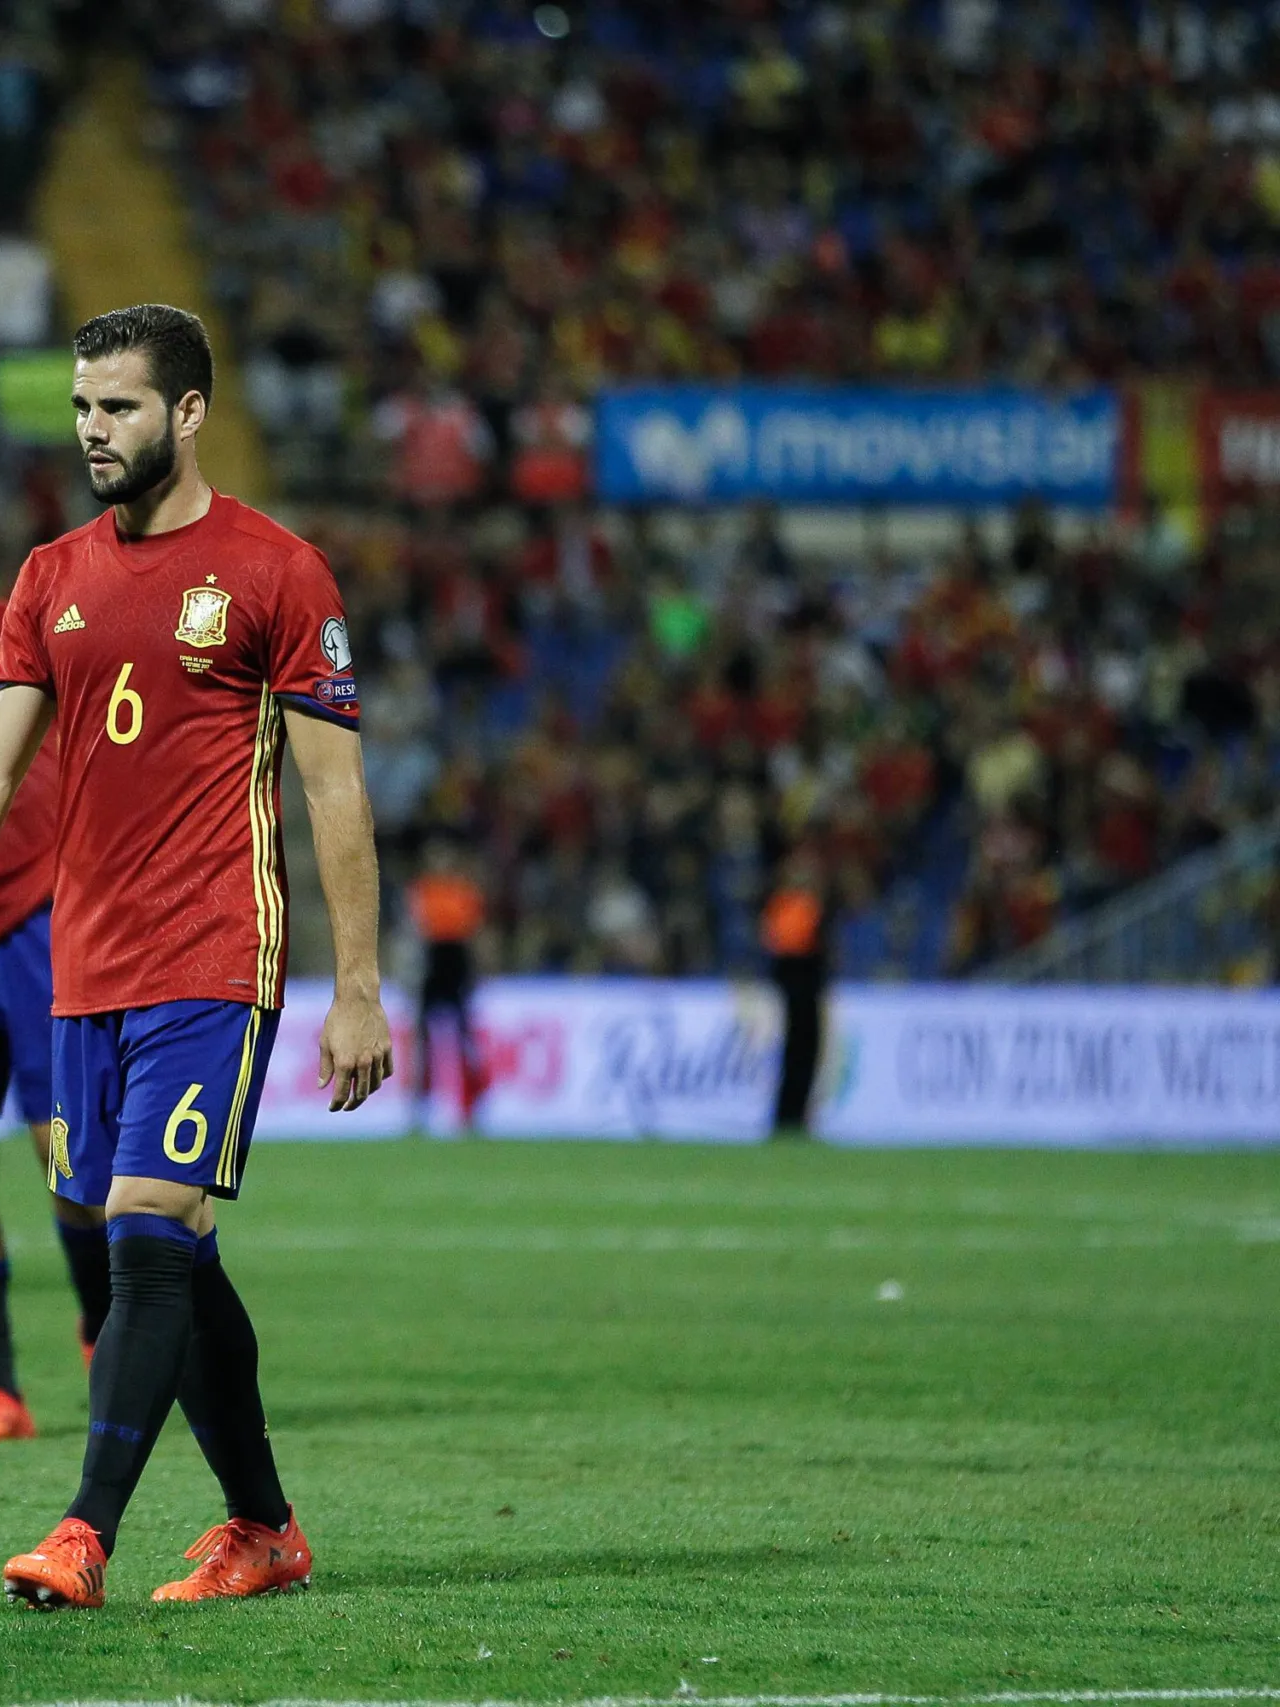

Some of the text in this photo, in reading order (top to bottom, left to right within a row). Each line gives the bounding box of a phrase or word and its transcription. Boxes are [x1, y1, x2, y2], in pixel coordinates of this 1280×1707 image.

[54, 619, 86, 634] adidas
[106, 662, 144, 746] 6
[163, 1083, 208, 1165] 6
